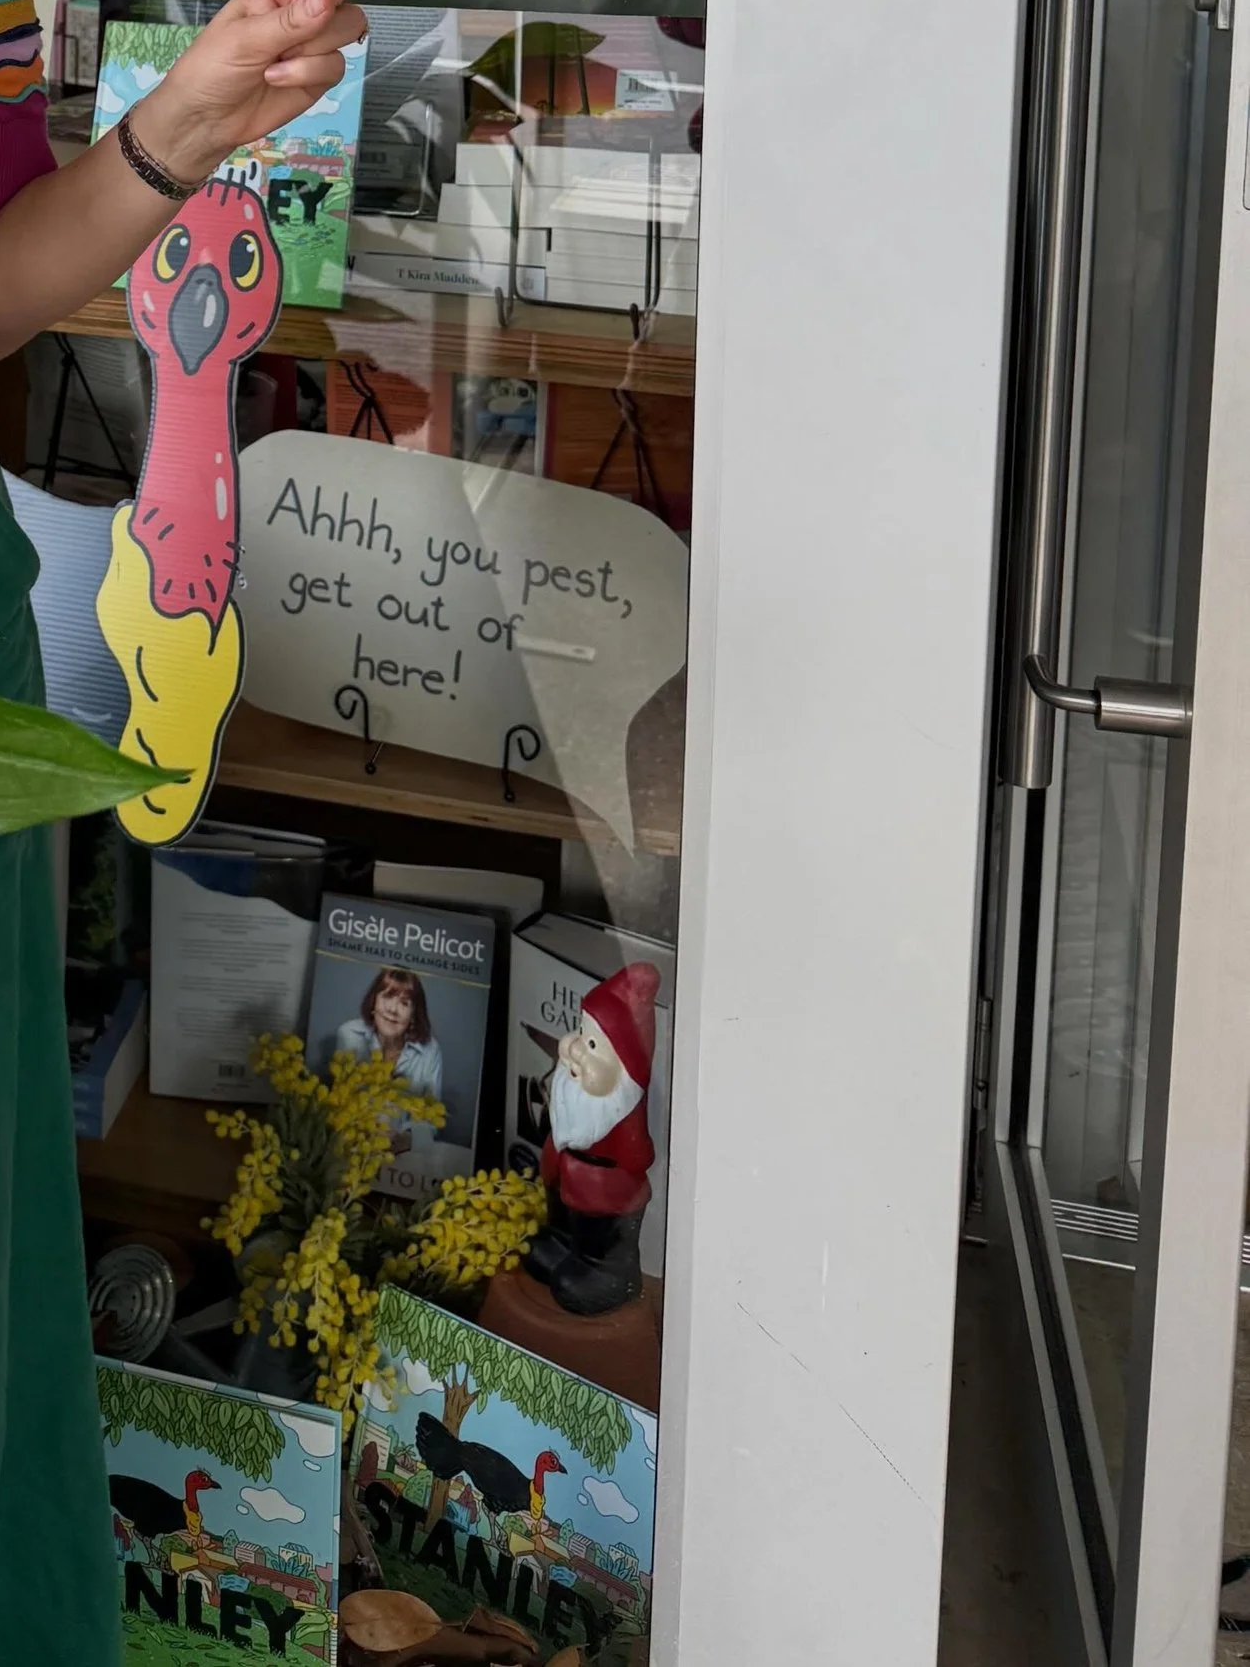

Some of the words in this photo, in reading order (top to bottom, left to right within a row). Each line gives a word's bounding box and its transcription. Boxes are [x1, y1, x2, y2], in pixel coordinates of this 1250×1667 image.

[407, 269, 430, 281] Kira
[266, 477, 402, 565] Ahhh,
[420, 536, 502, 587] you
[522, 560, 632, 619] pest,
[280, 571, 353, 615] get
[376, 592, 450, 633] out
[476, 613, 525, 651] of
[352, 633, 462, 701] here!
[328, 908, 398, 945] Gisèle
[404, 923, 485, 962] Pelicot
[328, 937, 363, 952] SHAME
[365, 945, 386, 958] HAS
[388, 950, 401, 960] TO
[405, 953, 448, 970] CHANGE
[451, 963, 480, 975] SIDES
[387, 1167, 415, 1188] TO
[365, 1481, 623, 1662] STANLEY
[125, 1560, 305, 1658] NLEY
